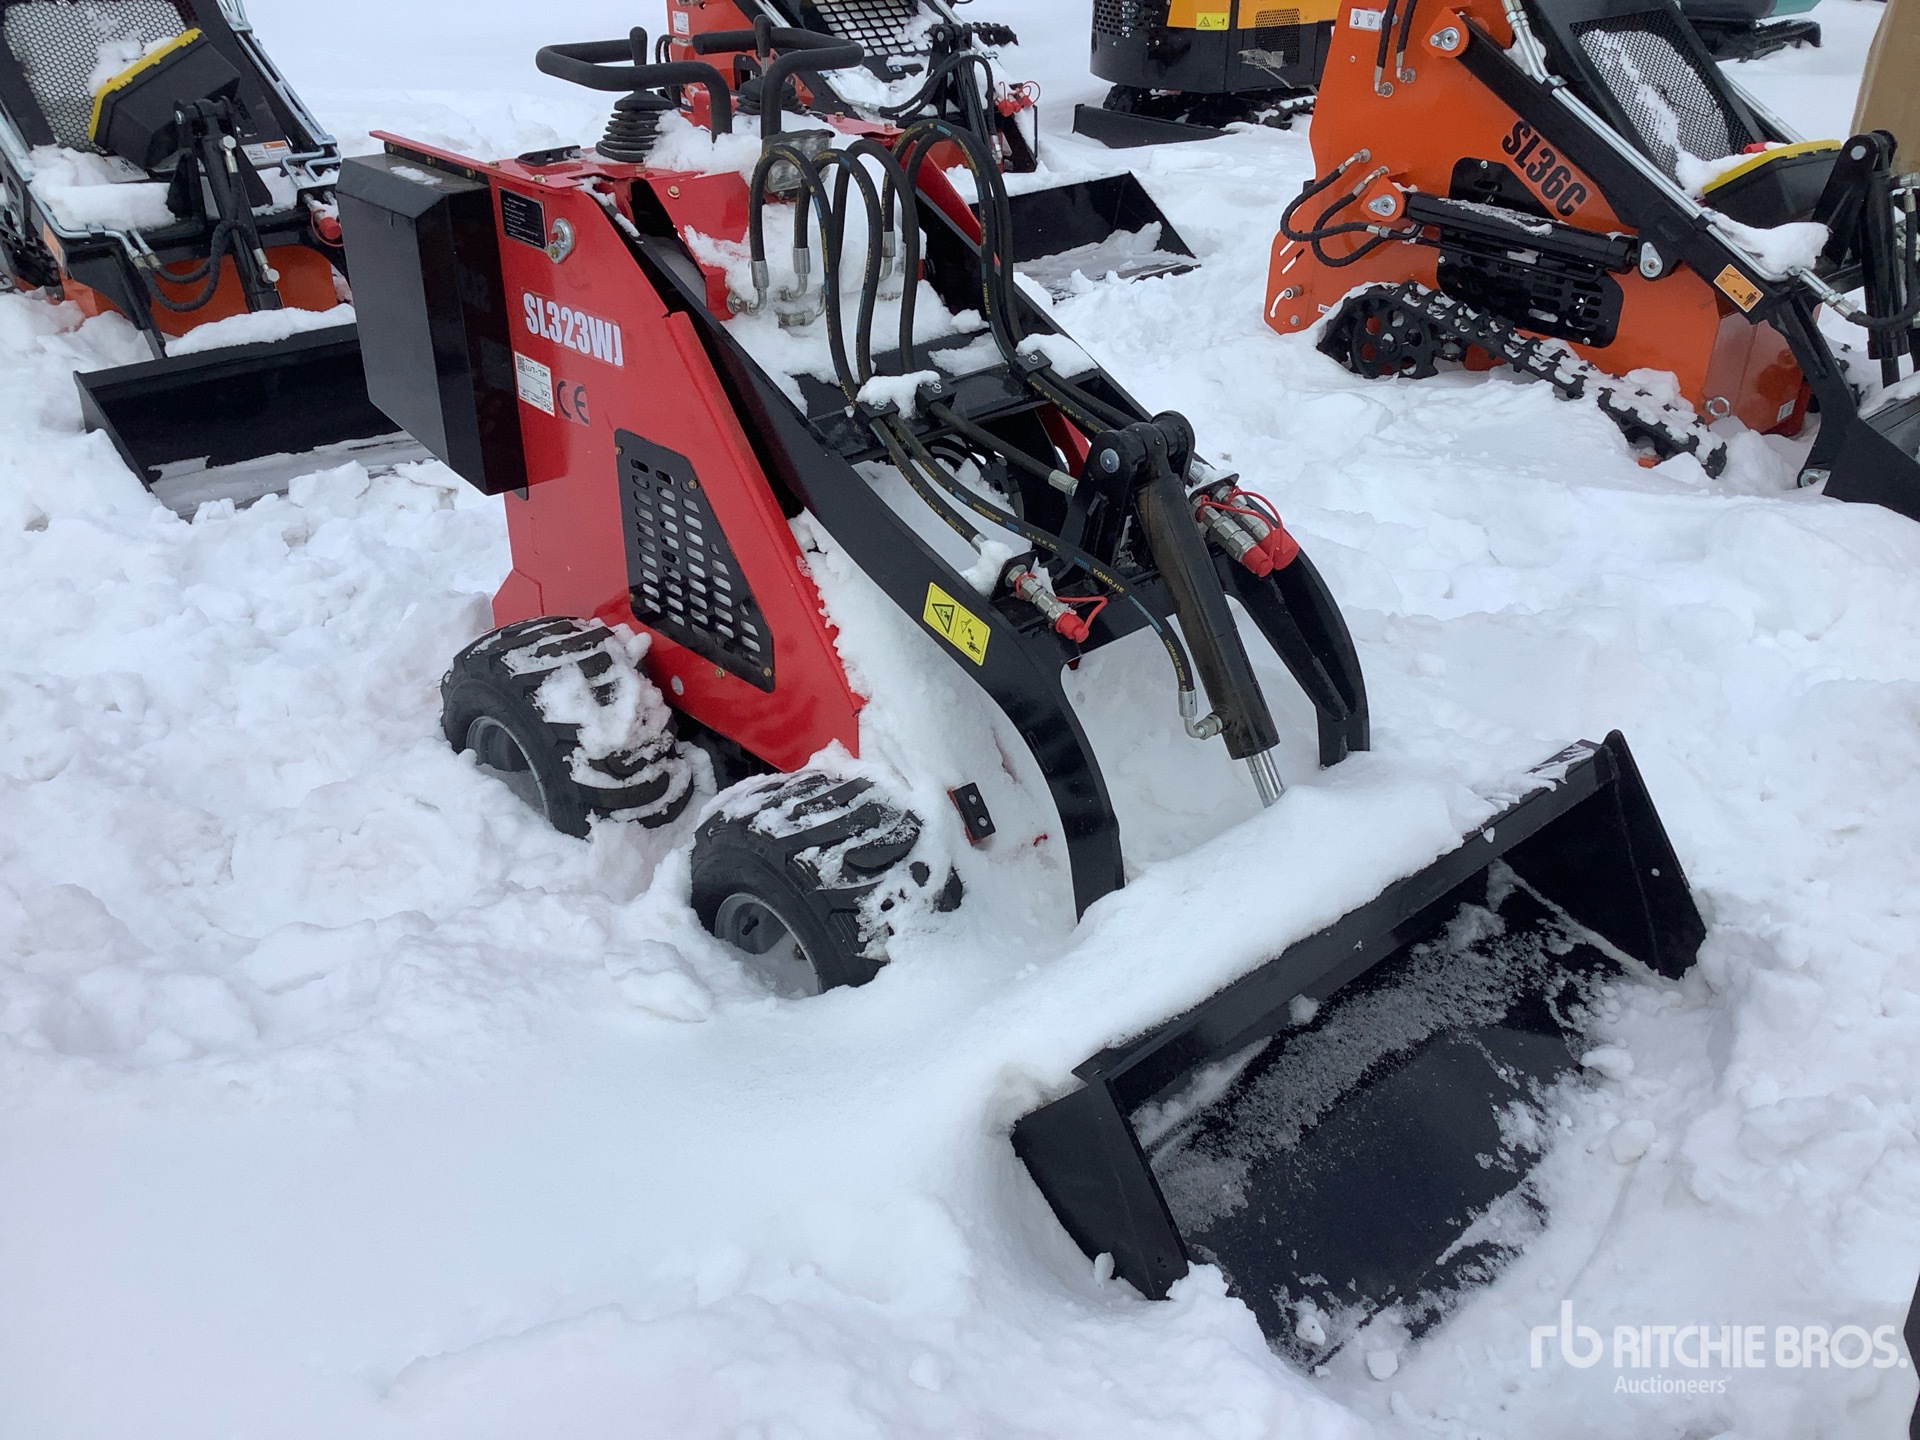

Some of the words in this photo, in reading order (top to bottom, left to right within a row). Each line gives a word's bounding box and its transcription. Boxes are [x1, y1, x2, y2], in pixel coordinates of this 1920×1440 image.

[1502, 120, 1587, 217] SL36C
[522, 292, 624, 367] SL323WJ
[1092, 567, 1125, 594] YONGJIE
